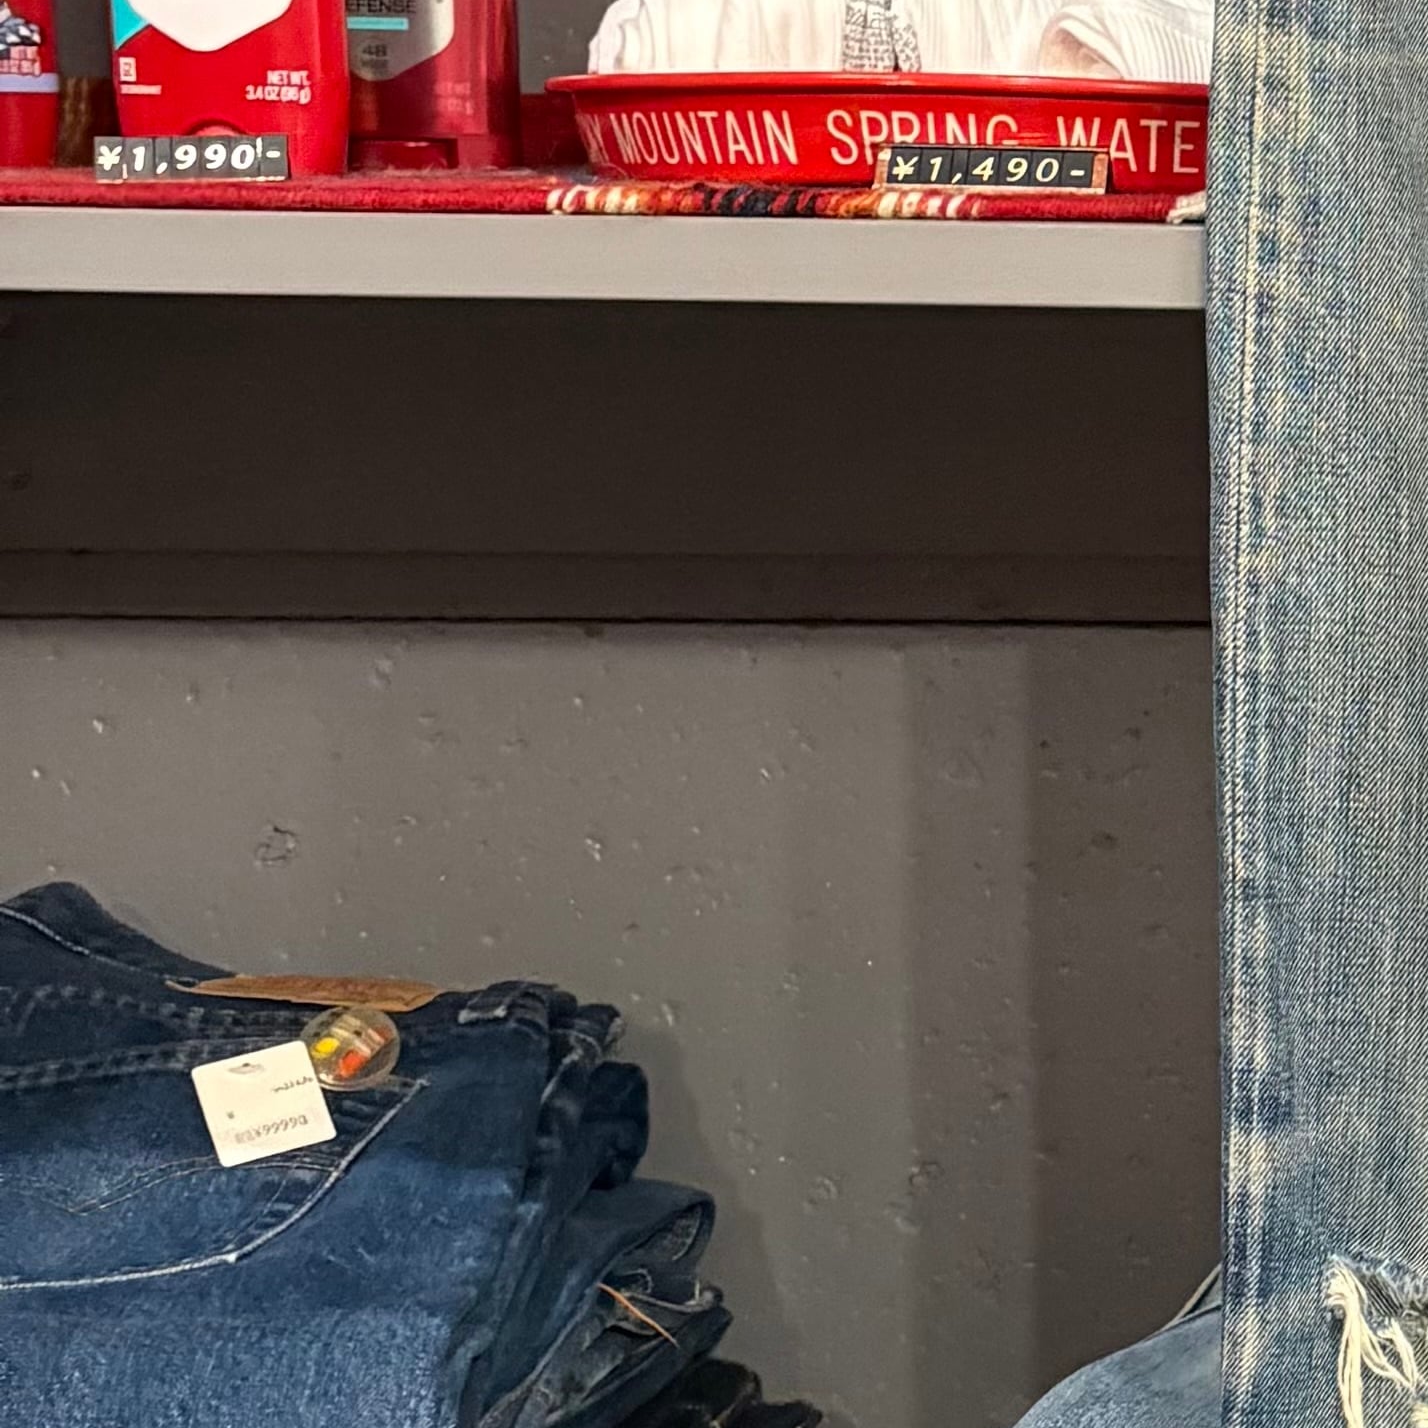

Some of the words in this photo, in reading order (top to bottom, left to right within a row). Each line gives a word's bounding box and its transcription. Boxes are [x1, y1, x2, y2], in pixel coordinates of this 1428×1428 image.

[609, 110, 798, 165] MOUNTAIN
[827, 110, 1018, 165] SPRING
[1057, 115, 1200, 173] WATE
